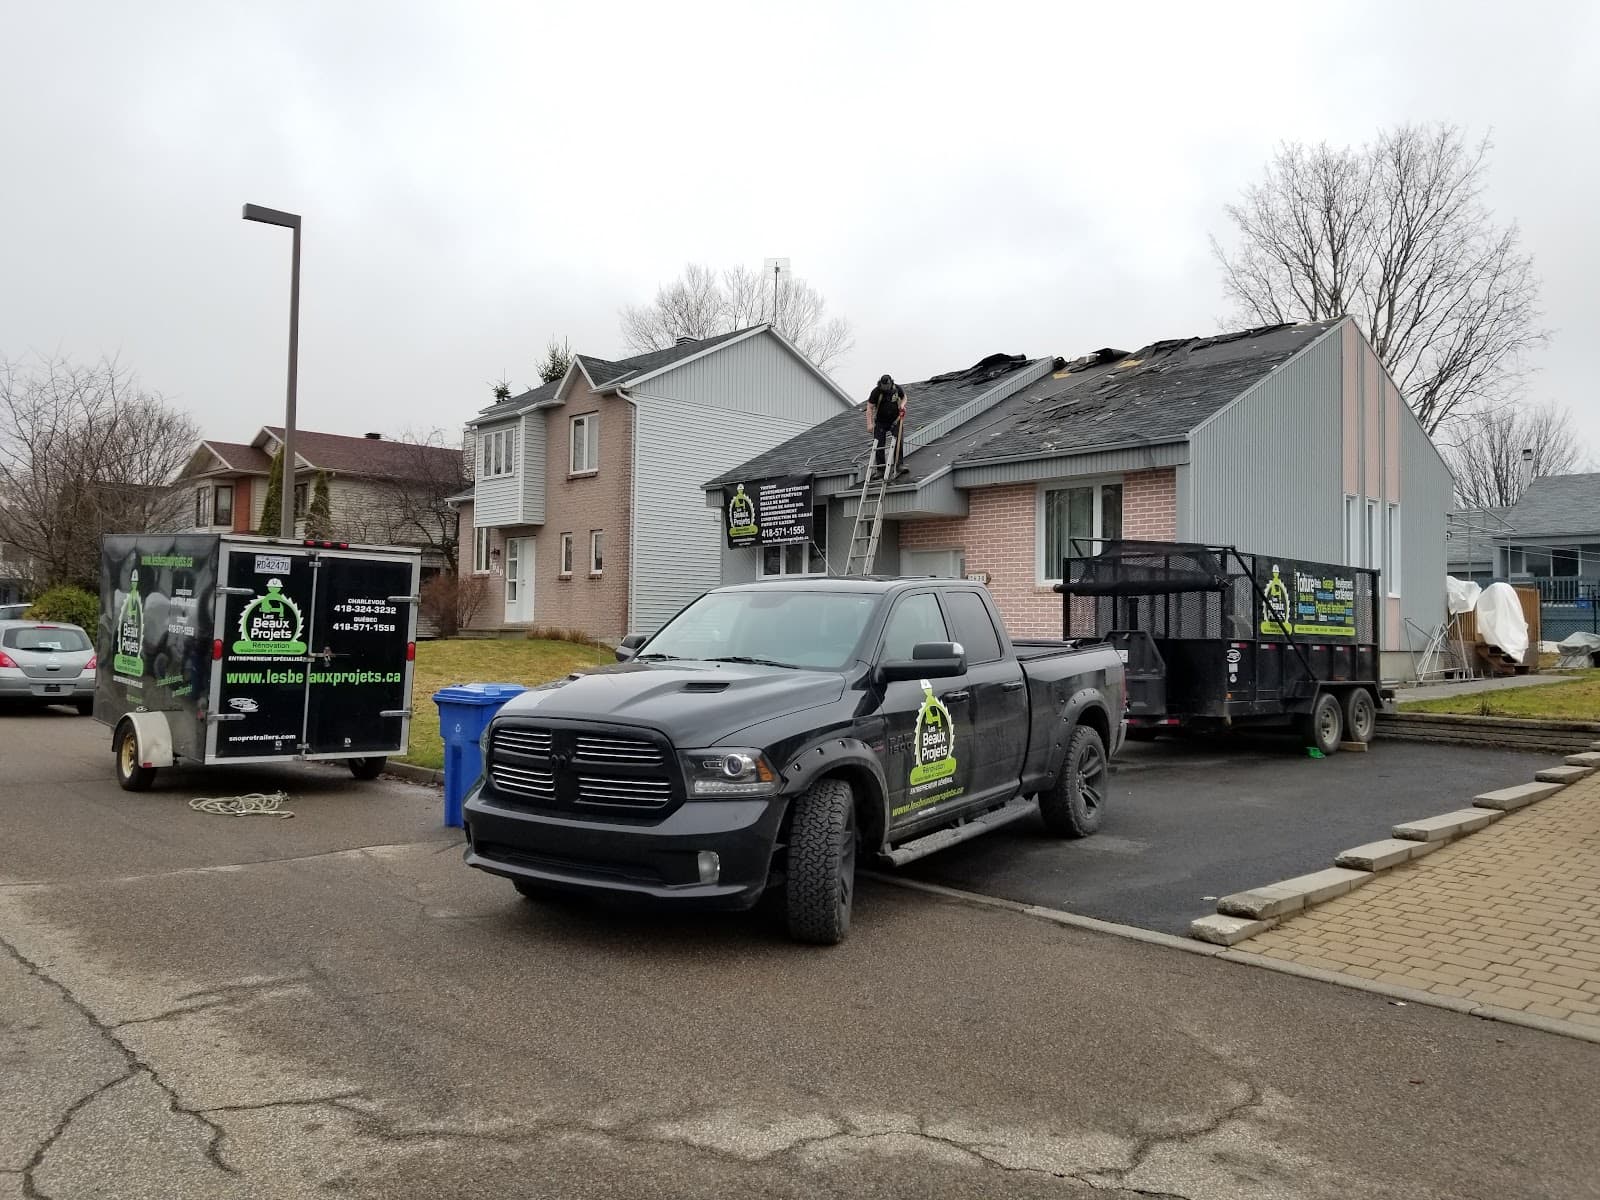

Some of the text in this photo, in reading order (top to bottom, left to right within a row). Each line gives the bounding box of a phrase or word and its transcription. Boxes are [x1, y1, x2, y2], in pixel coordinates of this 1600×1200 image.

[762, 526, 805, 538] 418-571-1558
[1296, 572, 1314, 593] Toiture
[334, 605, 396, 614] 418-324-3232
[253, 618, 290, 628] Beaux
[332, 623, 395, 632] 418-571-1558
[251, 628, 292, 640] Projets
[229, 734, 296, 742] snoprotrailers.com
[923, 732, 945, 746] Beaux
[922, 744, 947, 761] Projets
